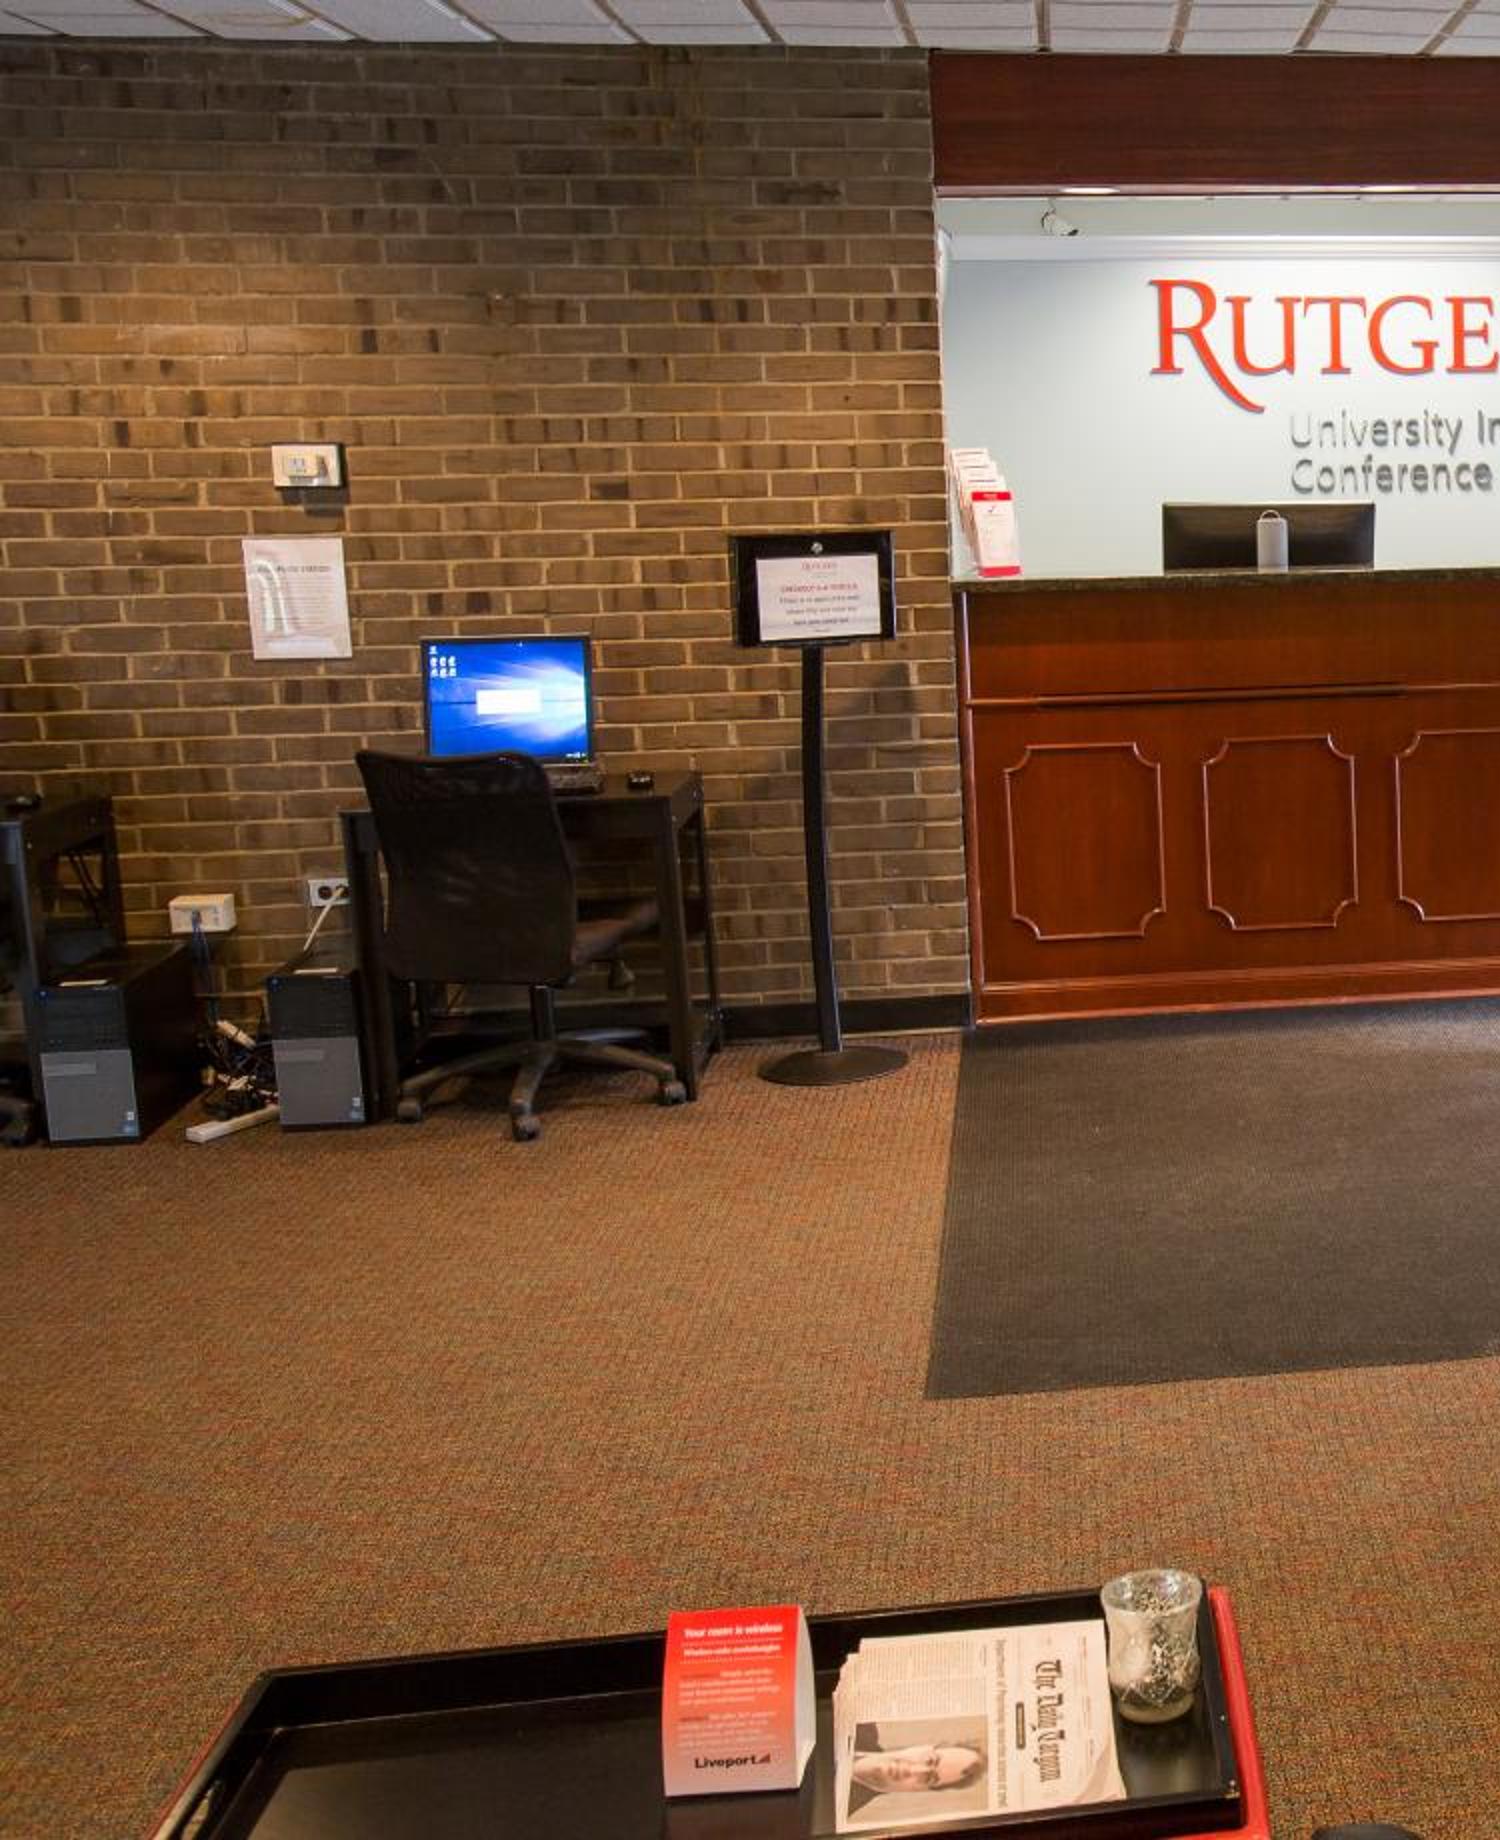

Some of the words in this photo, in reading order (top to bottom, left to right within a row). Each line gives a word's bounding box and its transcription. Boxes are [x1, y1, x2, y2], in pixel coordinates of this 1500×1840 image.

[1288, 409, 1463, 455] University
[1290, 453, 1493, 495] Conference
[1035, 1659, 1062, 1690] The
[1031, 1693, 1063, 1731] Daily
[694, 1754, 757, 1769] Liveport
